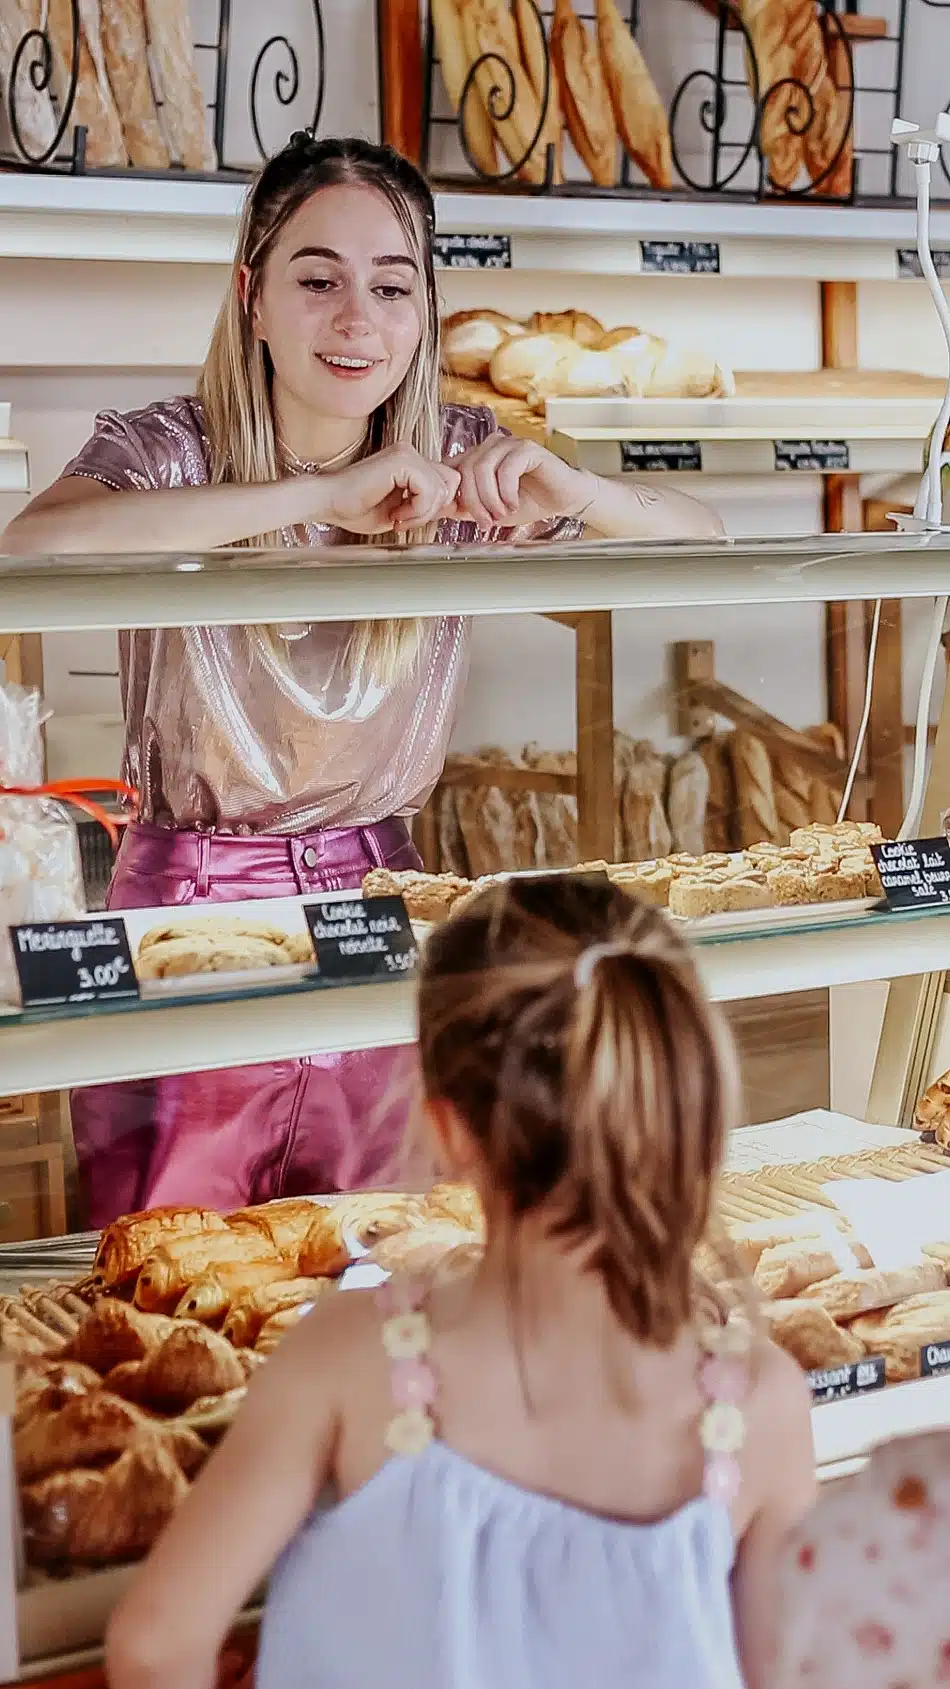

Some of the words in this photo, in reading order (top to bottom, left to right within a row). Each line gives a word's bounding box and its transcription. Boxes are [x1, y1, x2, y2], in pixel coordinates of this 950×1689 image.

[881, 843, 917, 858] Cookie
[877, 856, 920, 873] chocolat
[881, 870, 923, 887] caramel
[321, 902, 367, 921] Cookie
[313, 919, 369, 939] chocolat
[17, 923, 120, 962] Meringuette
